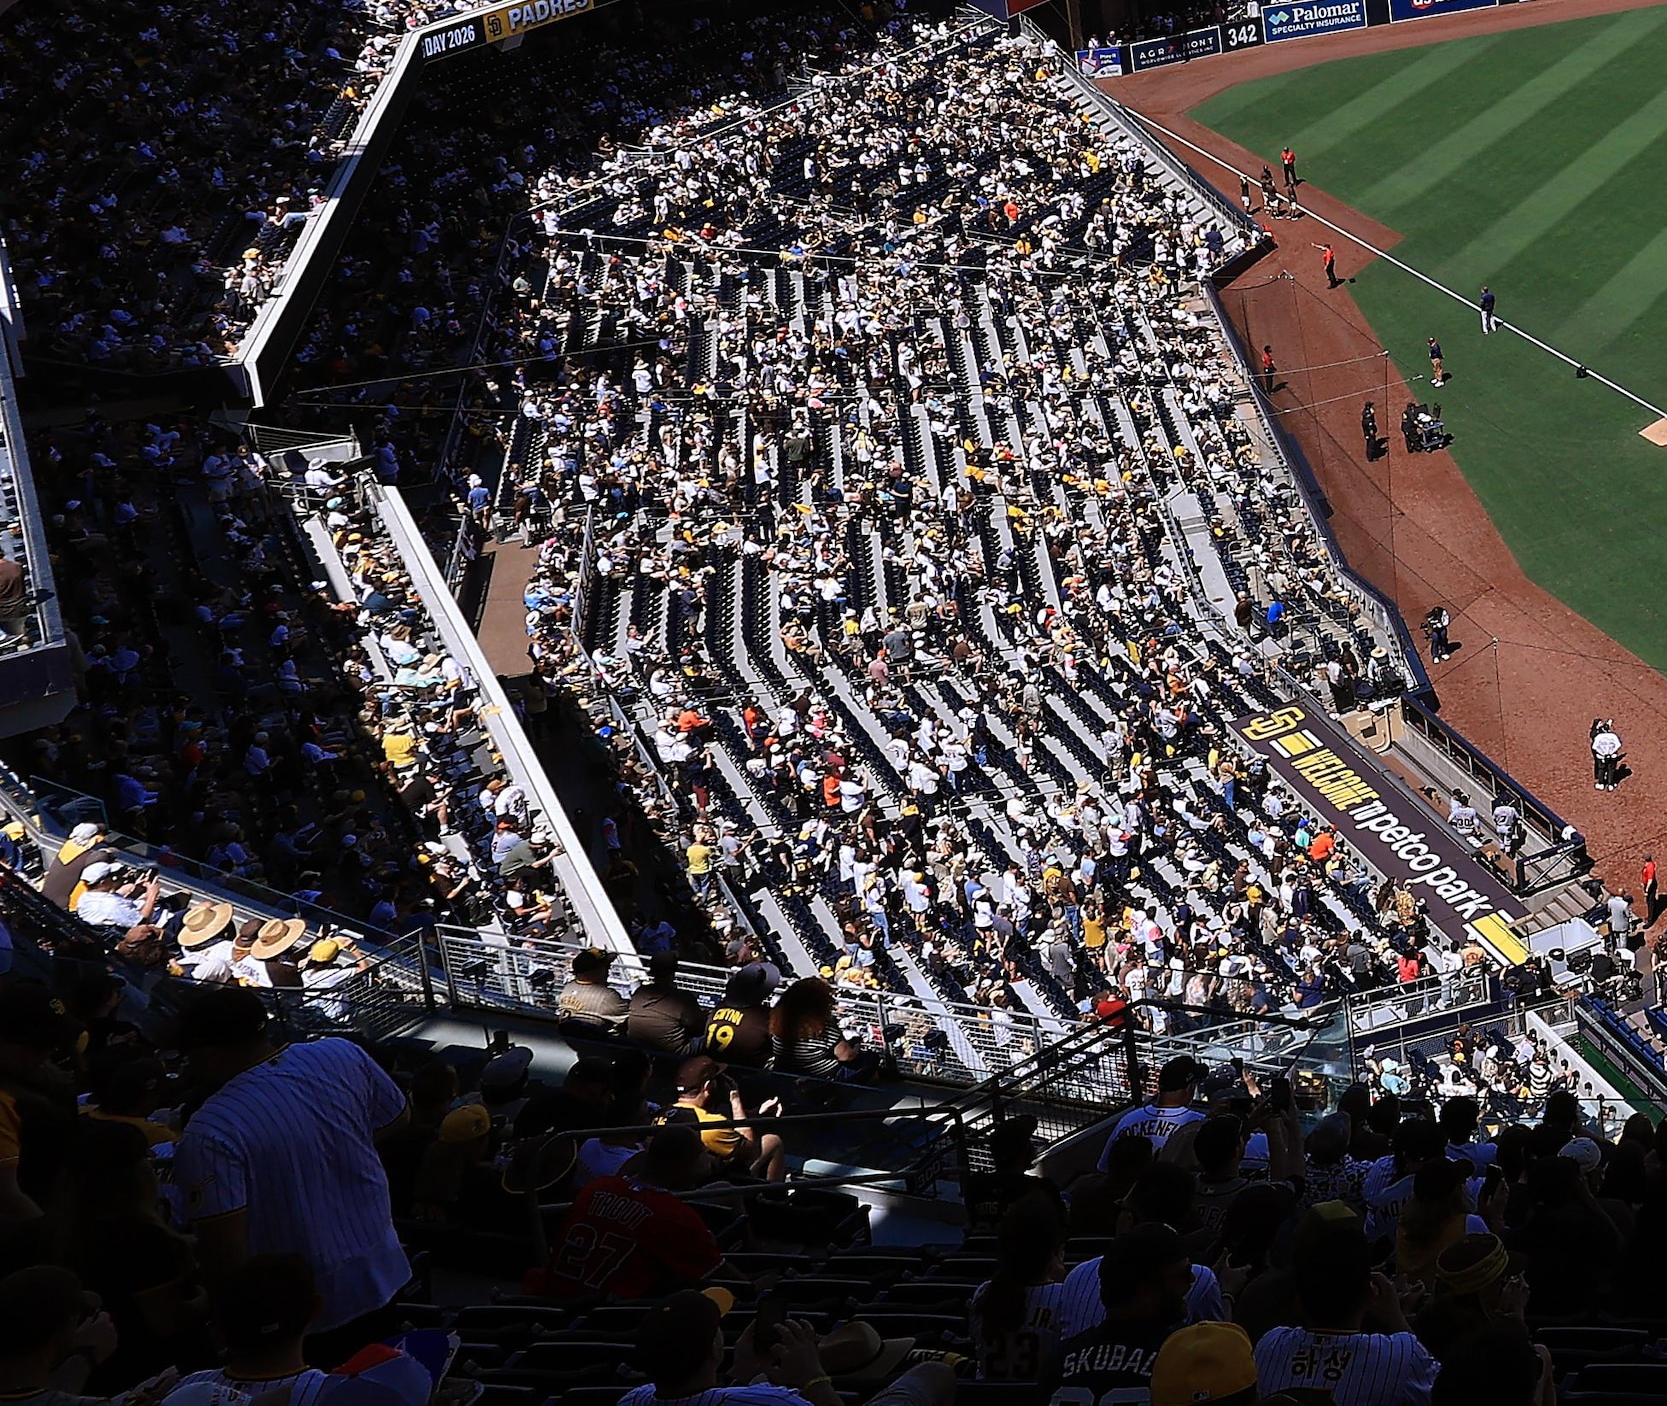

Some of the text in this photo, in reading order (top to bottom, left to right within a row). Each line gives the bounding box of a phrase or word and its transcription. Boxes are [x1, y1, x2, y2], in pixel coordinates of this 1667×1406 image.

[1272, 13, 1362, 36] SPECIALTY INSURANCE
[1291, 0, 1360, 24] Palomar
[424, 25, 476, 58] DAY 2026
[1228, 24, 1258, 47] 342
[1290, 747, 1380, 813] WELCOME
[1361, 808, 1494, 921] petco park
[707, 1024, 735, 1051] 19
[589, 1191, 655, 1231] TROUT
[552, 1223, 638, 1290] 27
